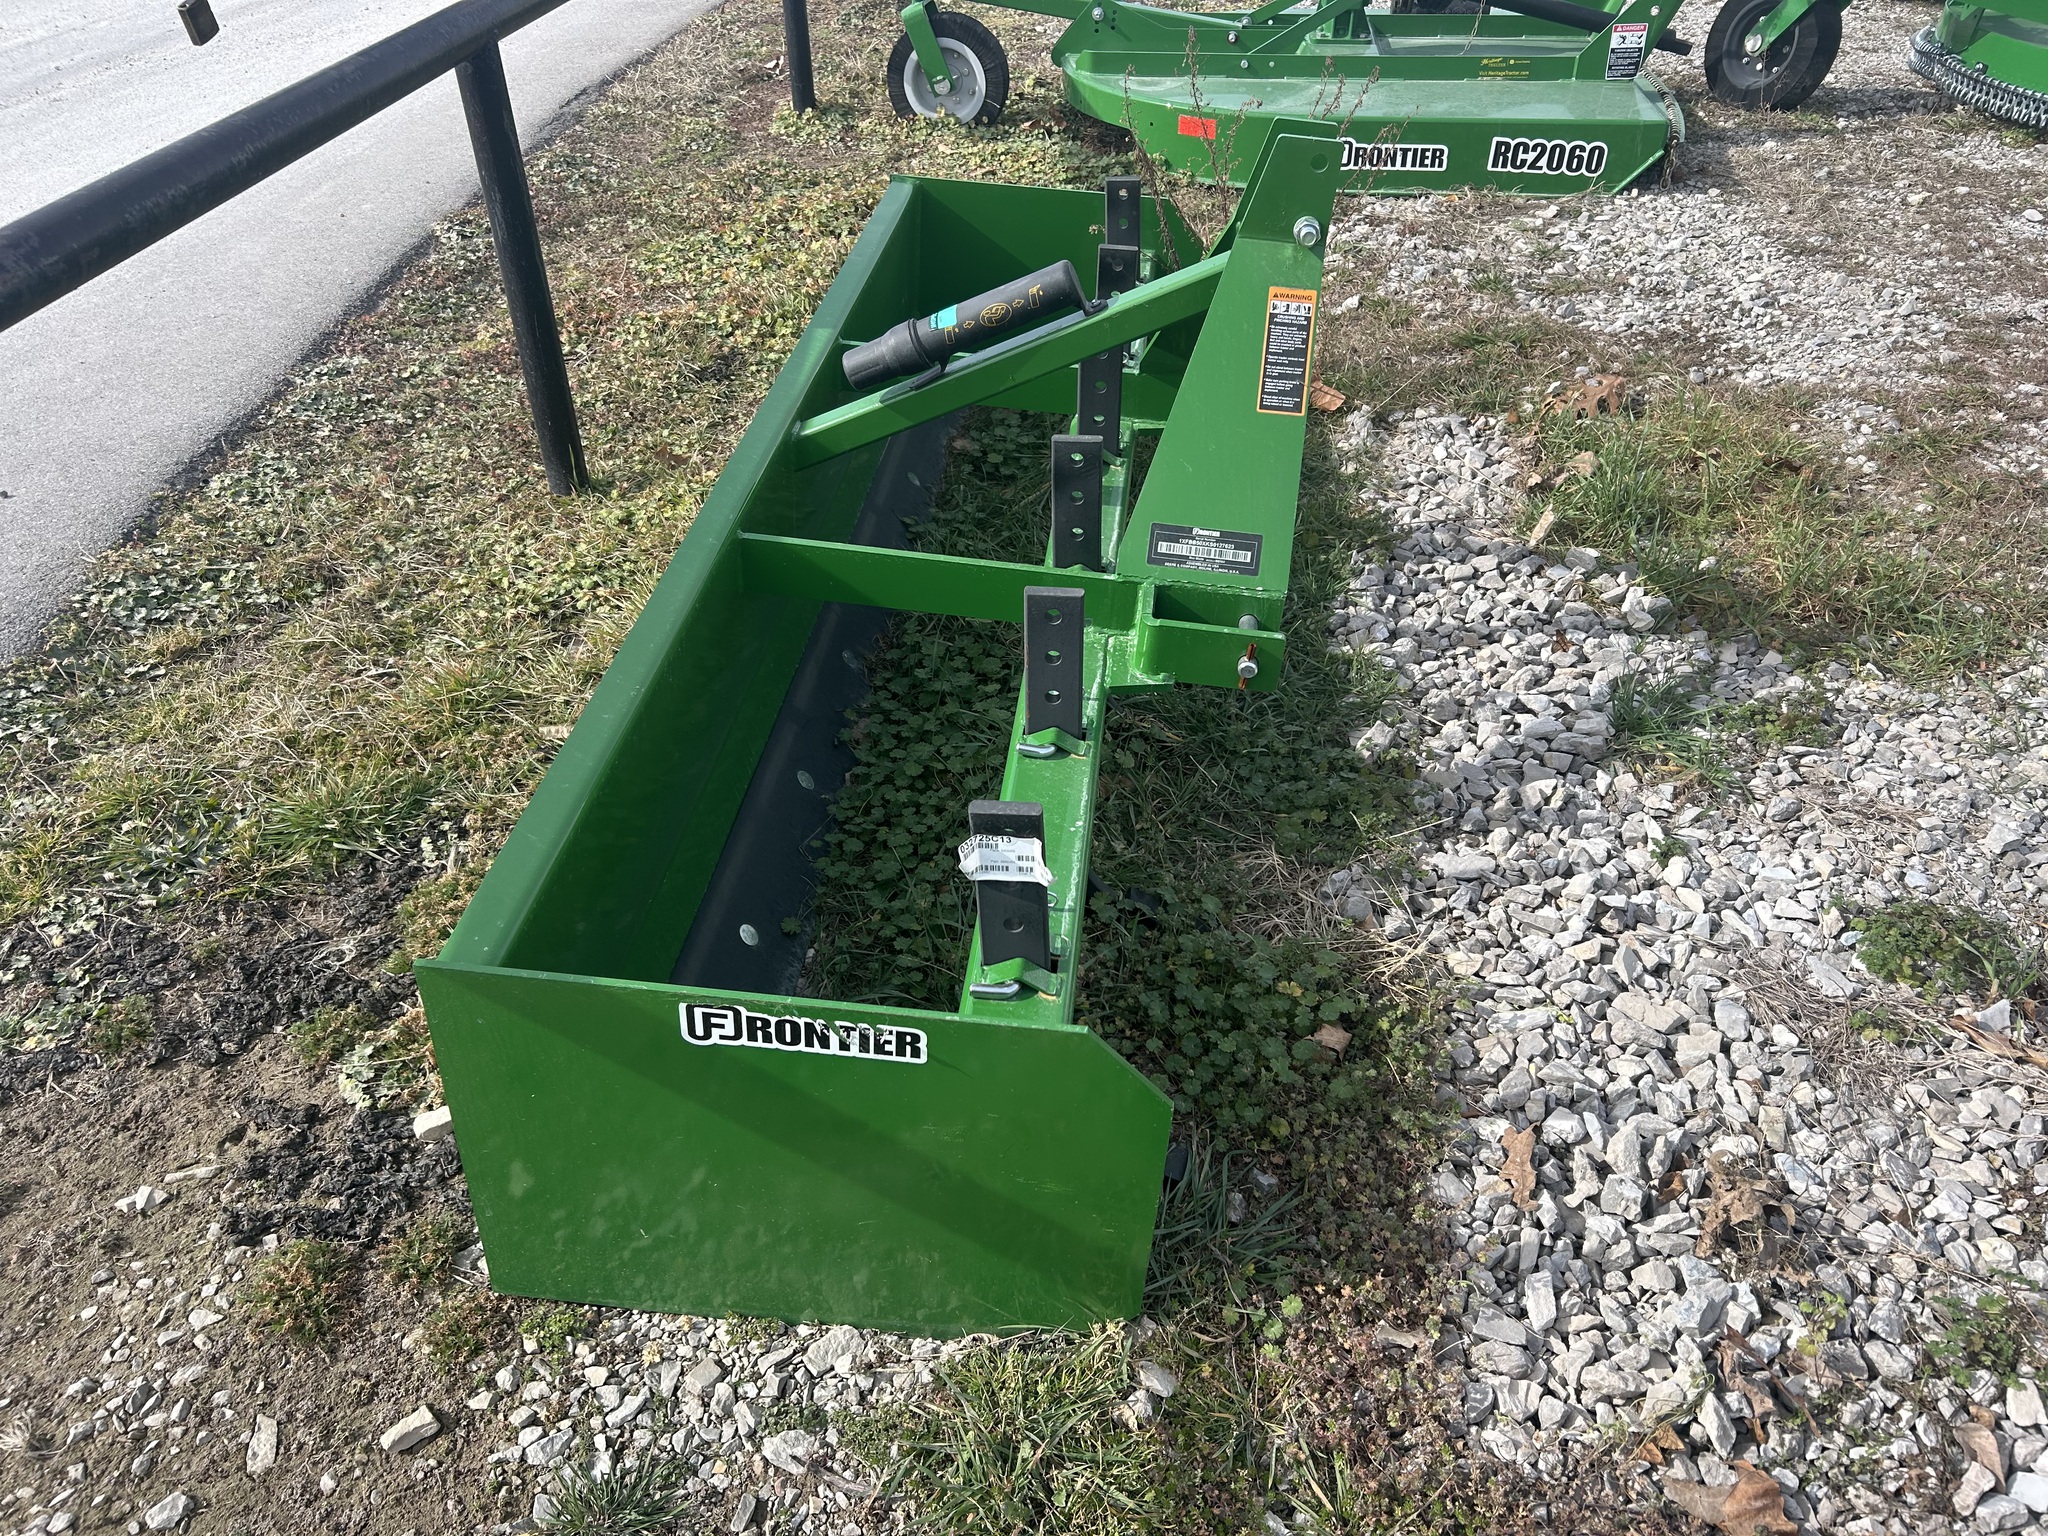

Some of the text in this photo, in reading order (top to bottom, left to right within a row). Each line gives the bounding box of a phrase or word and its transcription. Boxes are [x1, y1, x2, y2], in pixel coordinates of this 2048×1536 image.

[1341, 140, 1445, 169] RONTIER
[1491, 140, 1606, 175] RC2060
[1279, 292, 1312, 301] WARNING
[960, 834, 1012, 854] 032725C13
[686, 1004, 922, 1059] FRONTIER
